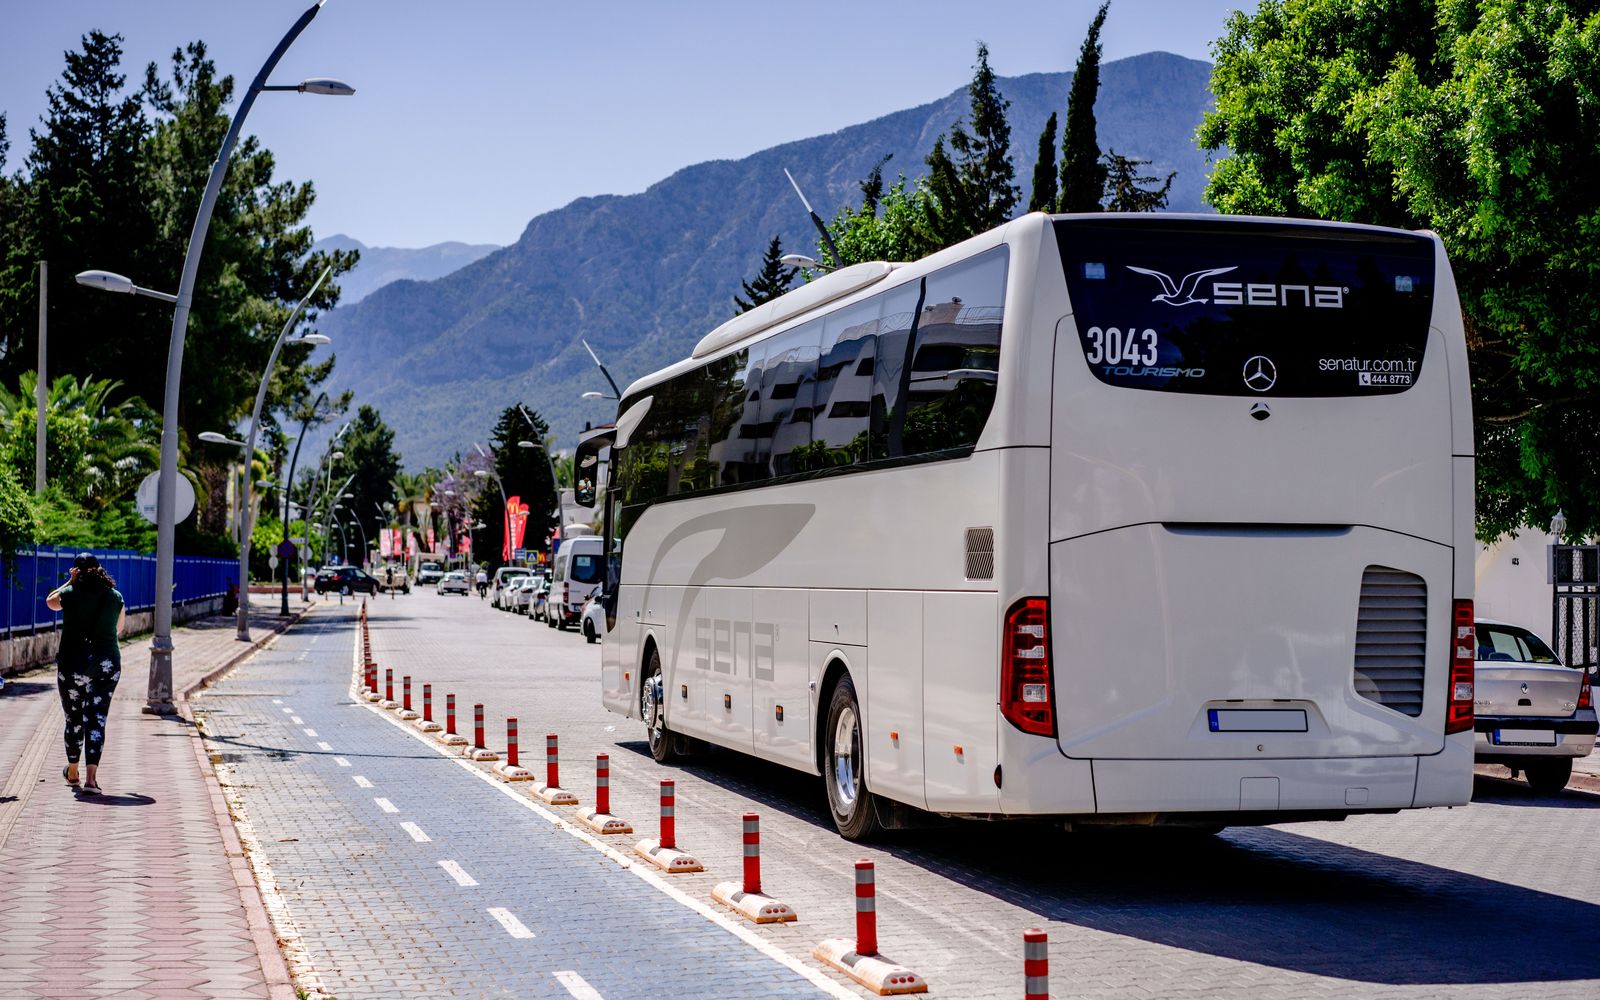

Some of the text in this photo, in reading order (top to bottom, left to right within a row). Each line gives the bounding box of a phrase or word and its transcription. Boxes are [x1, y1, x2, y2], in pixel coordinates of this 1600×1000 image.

[1087, 326, 1158, 366] 3043
[1319, 356, 1417, 371] senatur.com.tr
[1103, 366, 1205, 377] TOURISMO
[1371, 375, 1410, 384] 444 8773
